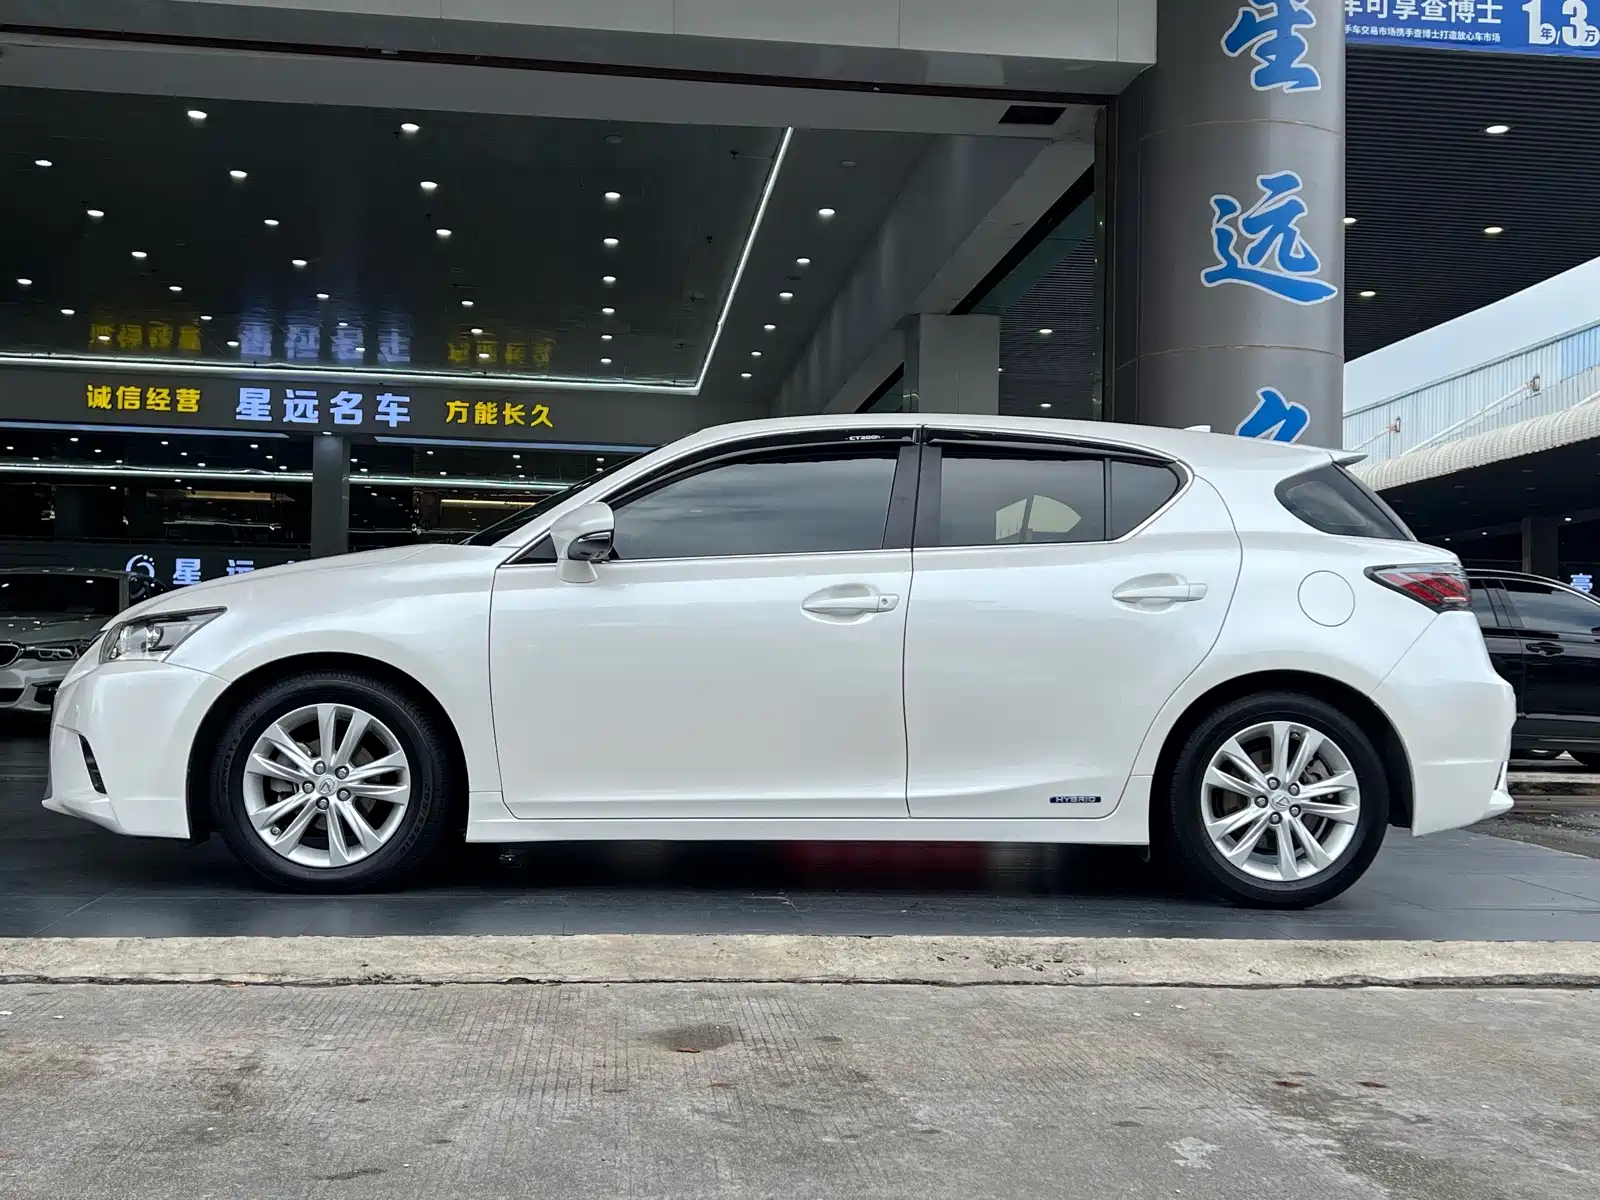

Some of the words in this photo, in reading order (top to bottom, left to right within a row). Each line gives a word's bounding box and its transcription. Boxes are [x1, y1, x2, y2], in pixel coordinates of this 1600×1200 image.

[86, 384, 201, 413] 诚信经营
[235, 387, 411, 428] 星远名车
[445, 400, 554, 428] 方能长久
